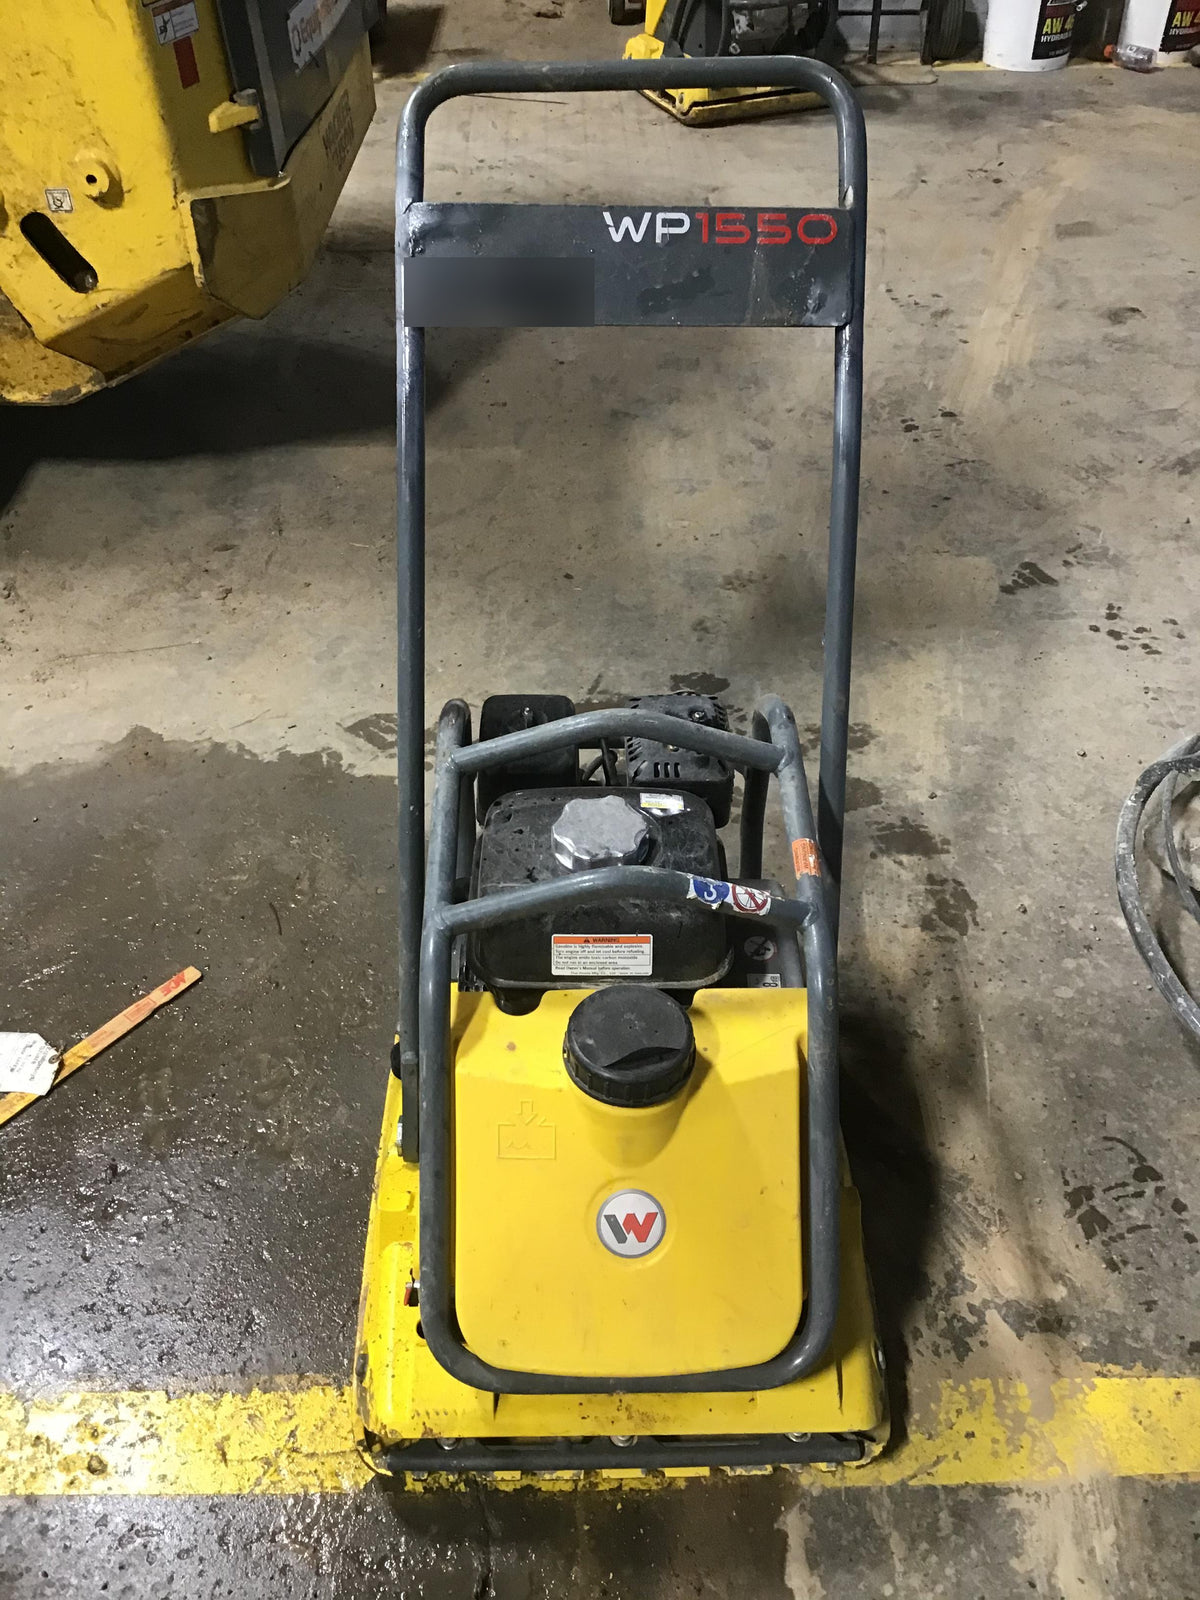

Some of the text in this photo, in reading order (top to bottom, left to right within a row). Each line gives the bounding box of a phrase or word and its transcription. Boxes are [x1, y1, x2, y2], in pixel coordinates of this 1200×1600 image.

[1042, 17, 1064, 34] AW
[1172, 11, 1194, 27] AW
[602, 211, 838, 245] WP1550
